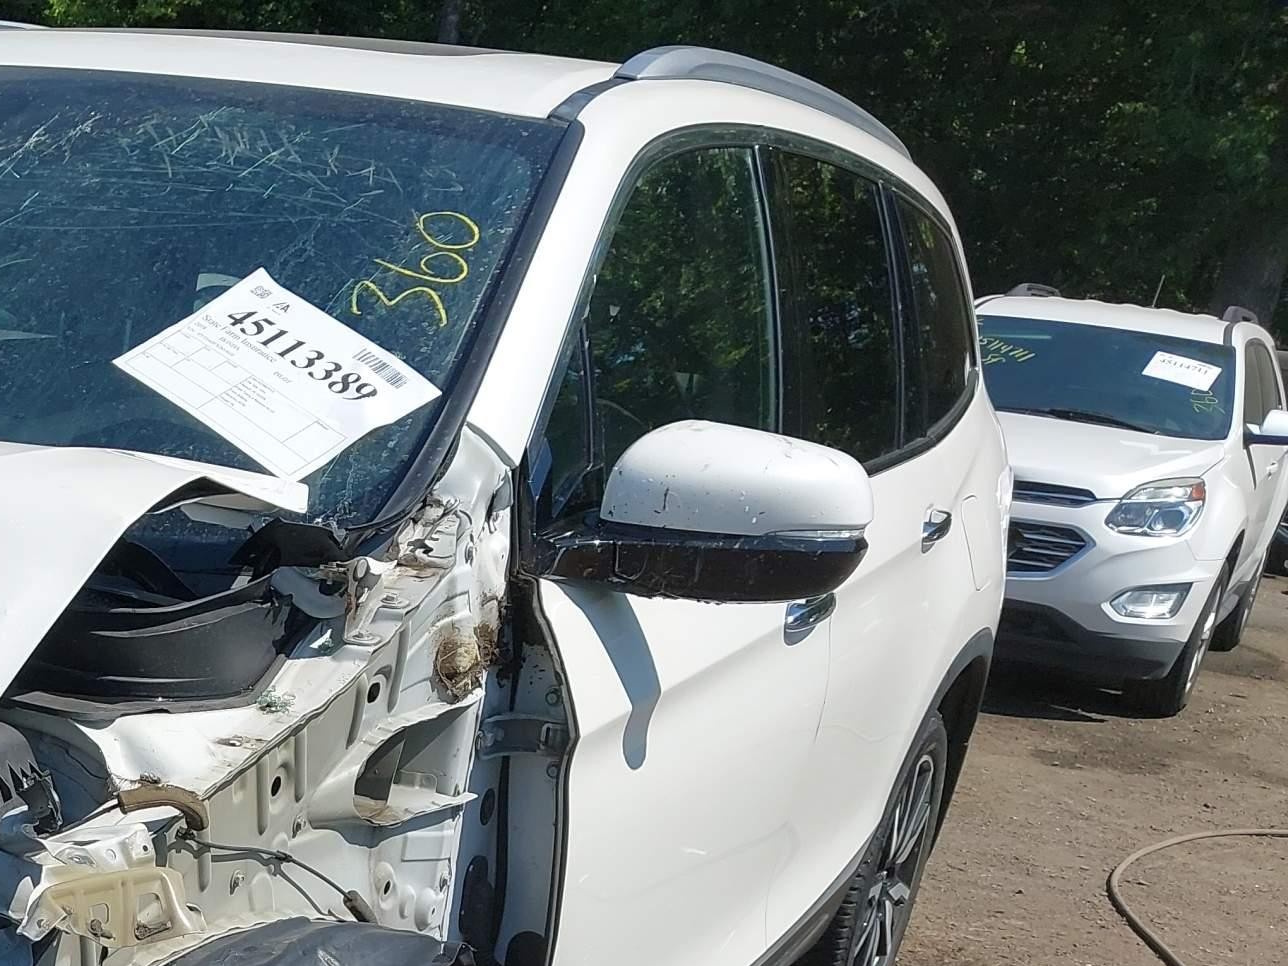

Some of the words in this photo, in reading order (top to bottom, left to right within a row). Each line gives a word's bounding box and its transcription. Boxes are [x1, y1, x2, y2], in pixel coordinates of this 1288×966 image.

[351, 210, 480, 327] 360
[202, 313, 222, 329] State
[221, 324, 241, 341] Farm
[241, 333, 277, 364] Insurance
[227, 311, 378, 401] 45113389
